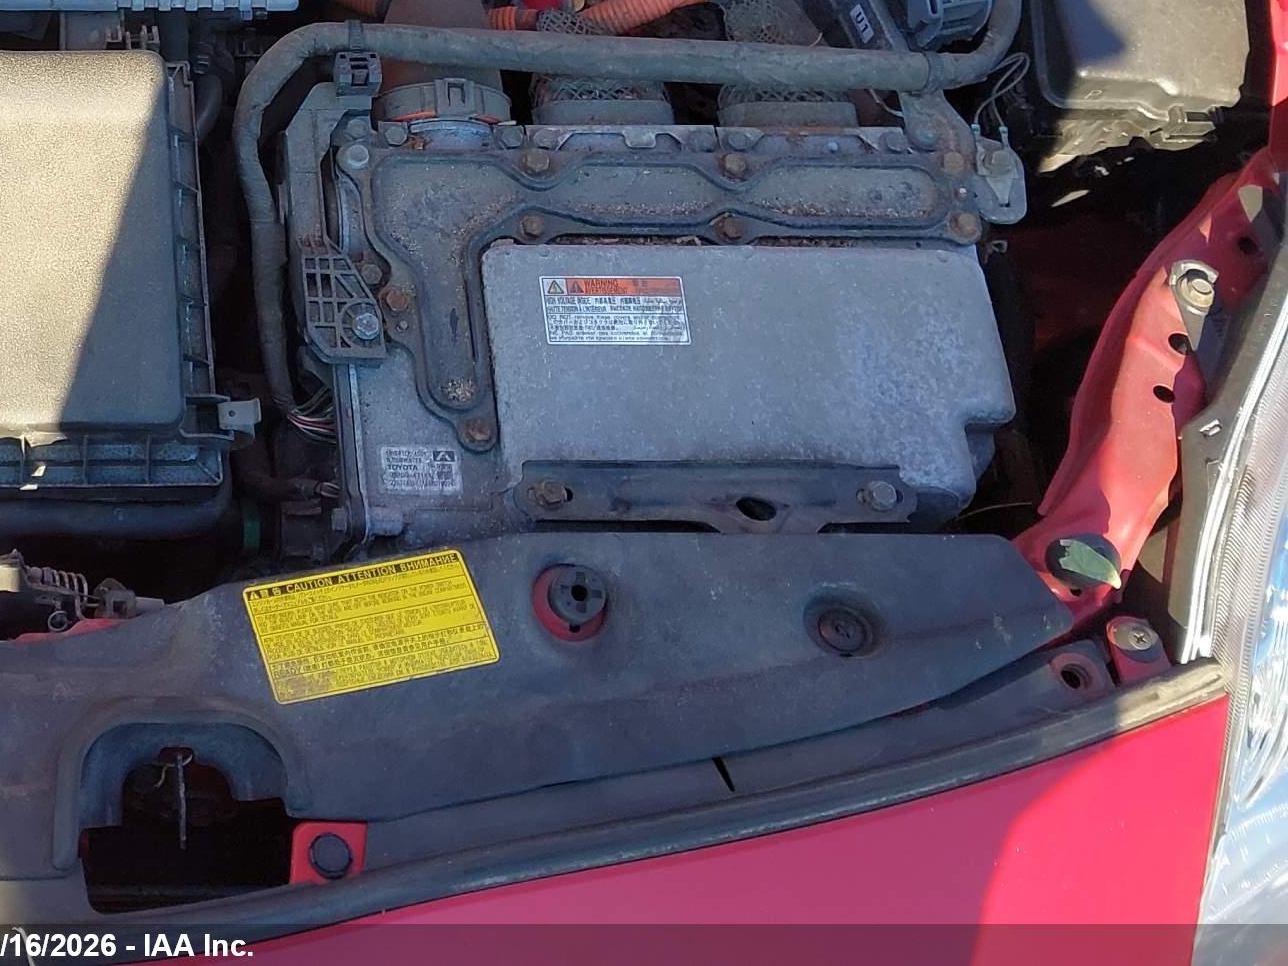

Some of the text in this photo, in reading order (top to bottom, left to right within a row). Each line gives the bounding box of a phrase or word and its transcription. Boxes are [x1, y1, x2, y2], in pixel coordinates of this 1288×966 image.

[584, 279, 619, 288] WARNING
[286, 577, 333, 594] CAUTION
[337, 564, 397, 584] ATTENTION
[399, 552, 457, 573] ВНИМАНИЕ
